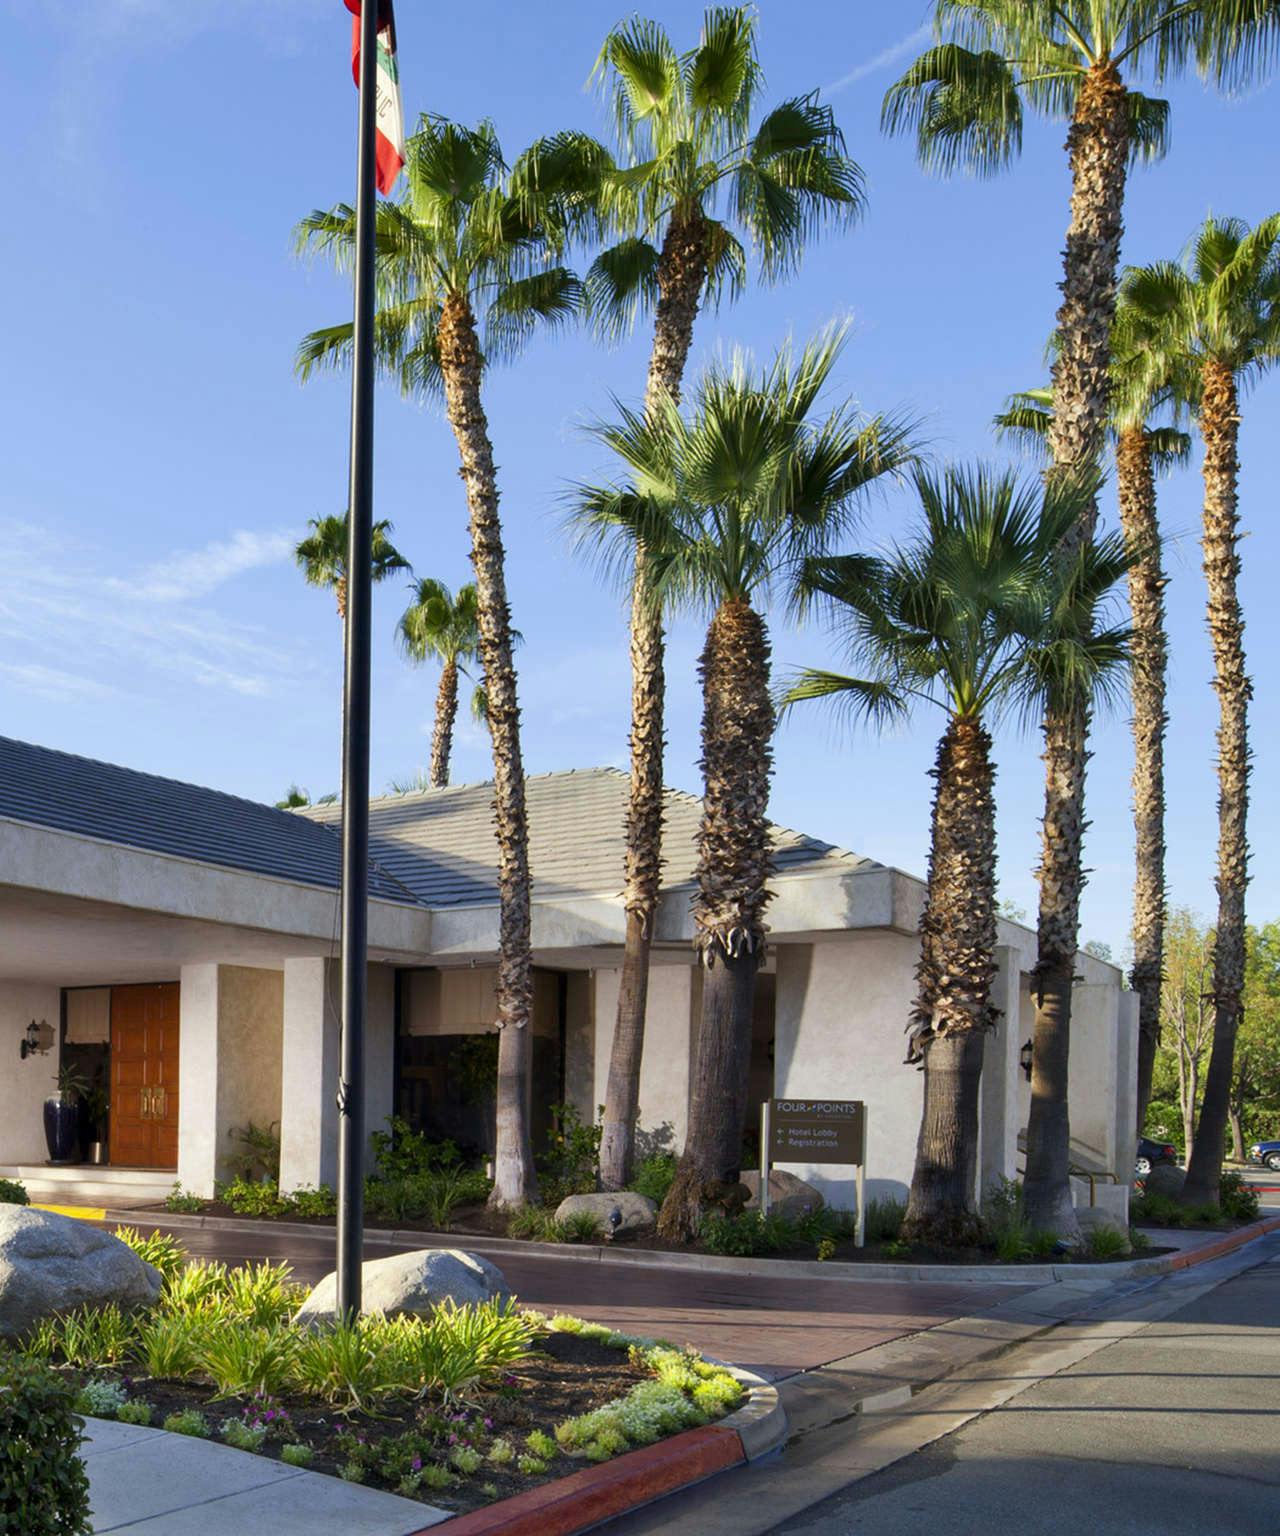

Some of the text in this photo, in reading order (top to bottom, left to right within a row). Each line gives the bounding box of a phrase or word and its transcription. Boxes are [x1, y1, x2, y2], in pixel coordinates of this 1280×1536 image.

[776, 1102, 856, 1114] FOUR POINTS
[788, 1128, 838, 1138] Hotel Lobby
[788, 1138, 839, 1147] Registration
